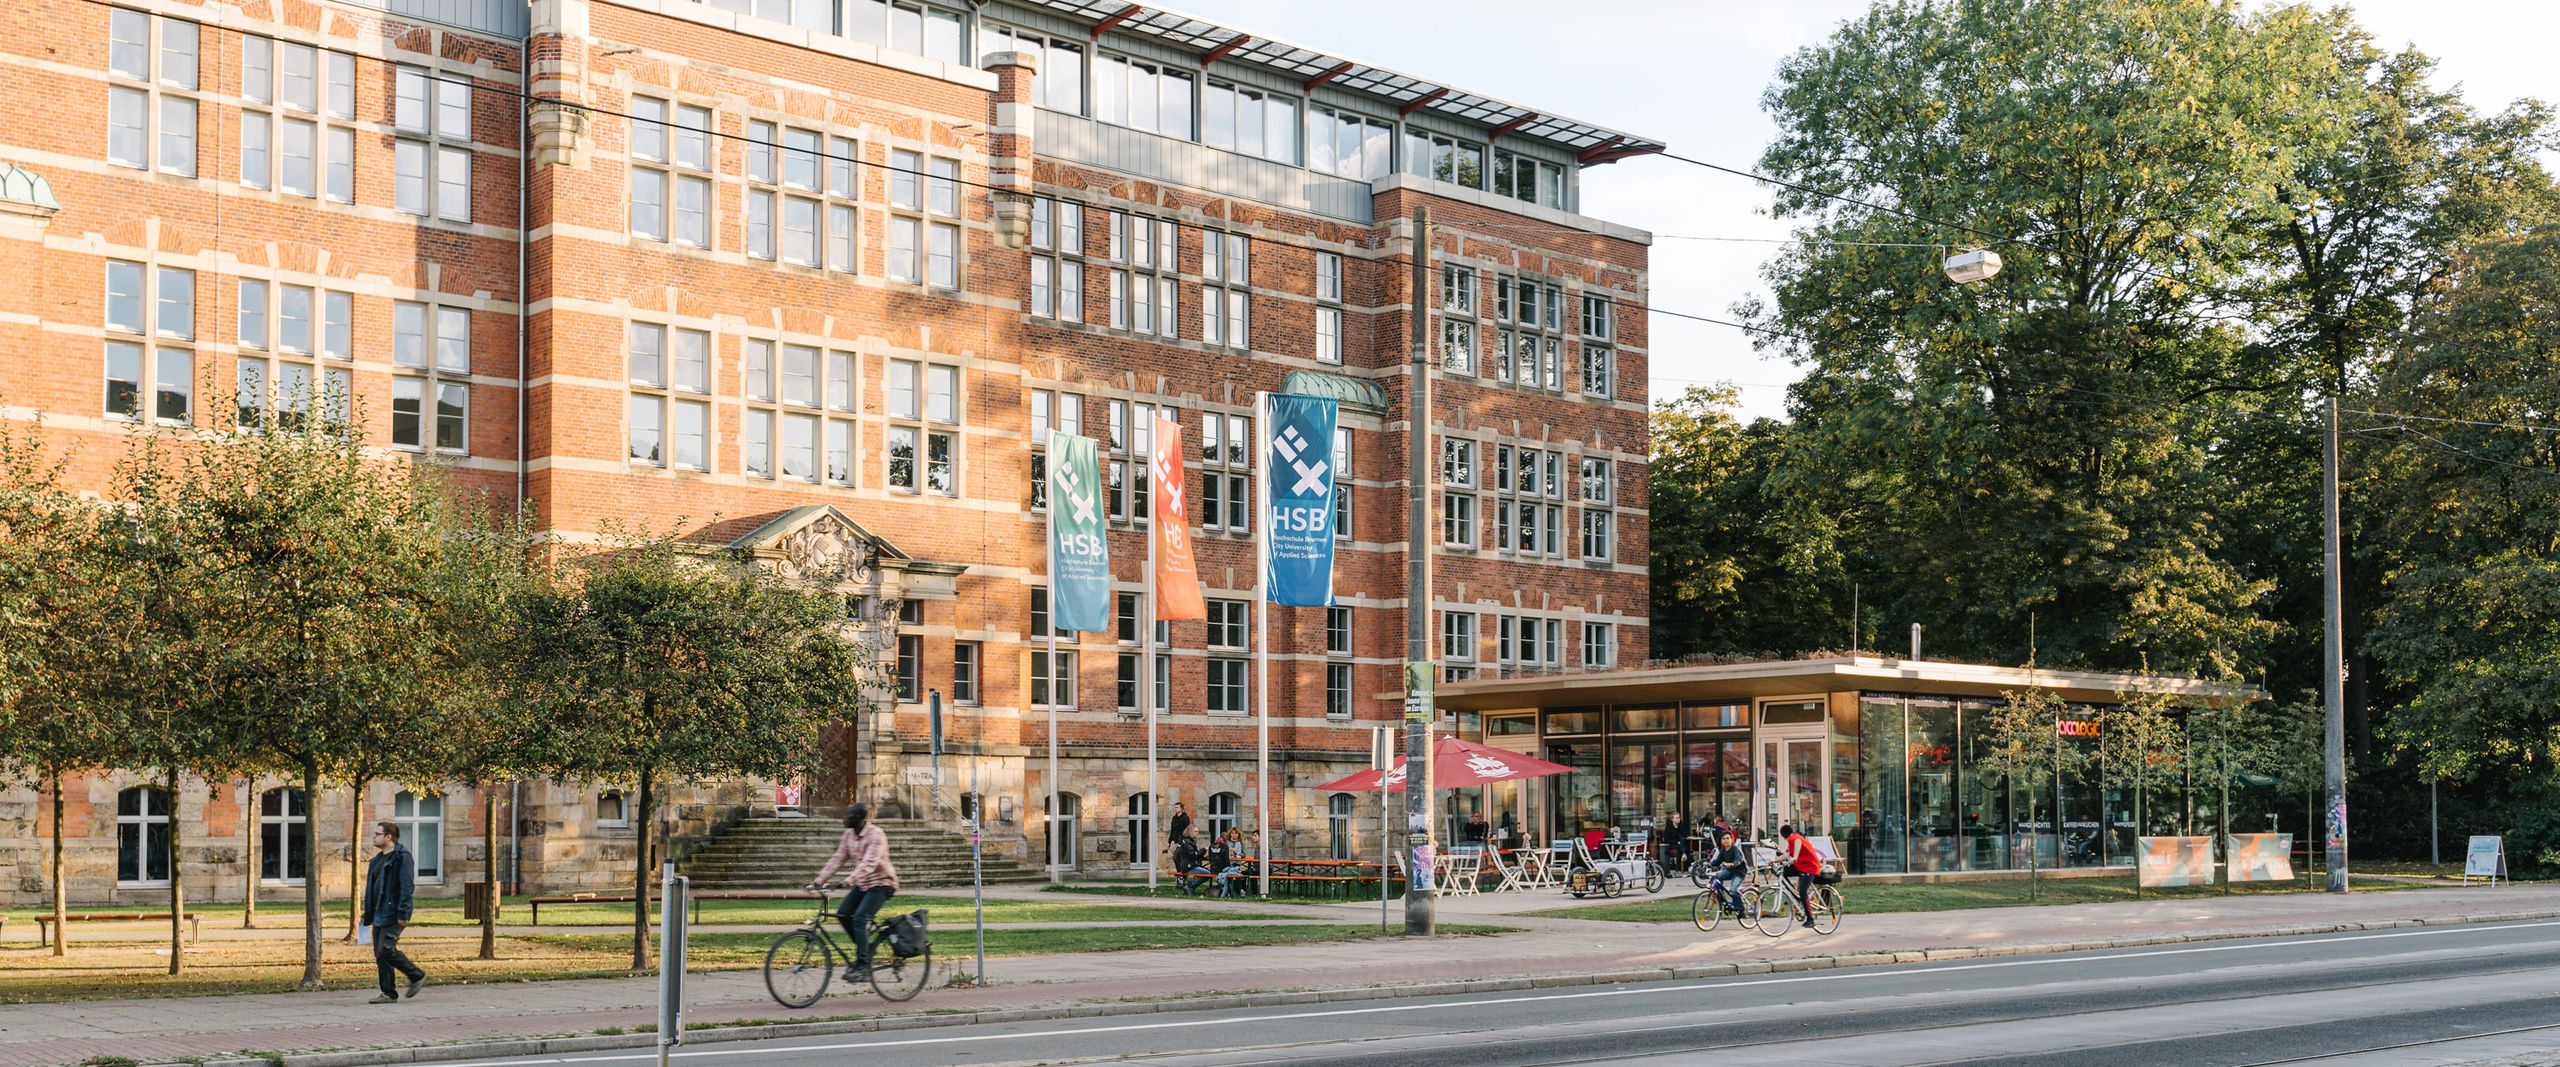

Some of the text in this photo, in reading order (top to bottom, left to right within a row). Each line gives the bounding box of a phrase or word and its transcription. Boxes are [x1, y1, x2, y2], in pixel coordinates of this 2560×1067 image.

[1272, 506, 1326, 532] HSB
[1060, 532, 1104, 557] HSB
[1285, 543, 1313, 552] University
